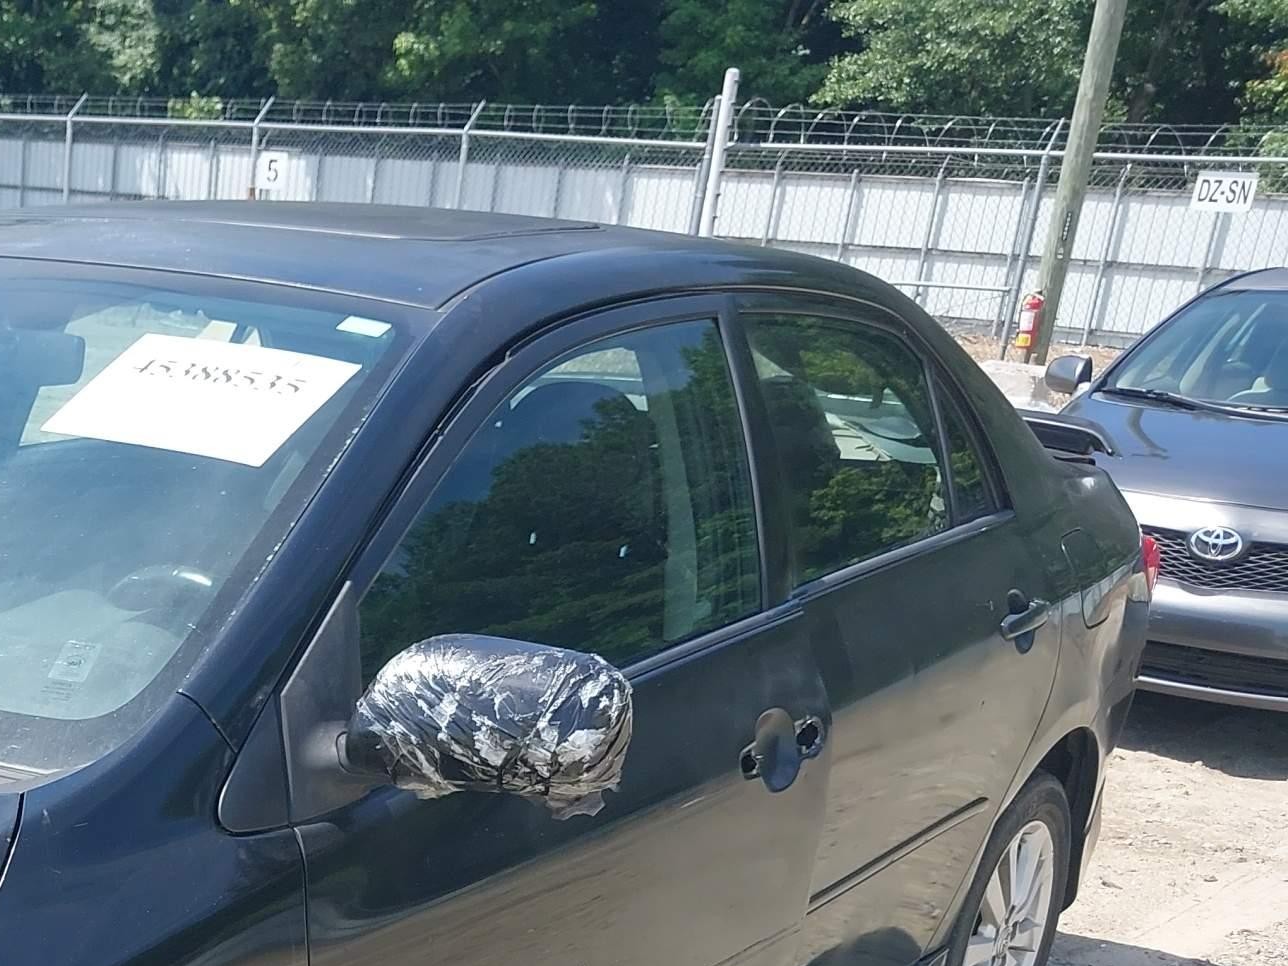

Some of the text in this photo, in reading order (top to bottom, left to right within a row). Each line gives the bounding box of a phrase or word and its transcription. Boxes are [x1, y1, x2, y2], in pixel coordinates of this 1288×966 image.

[267, 159, 279, 182] 5
[1197, 178, 1253, 205] DZ-SN
[133, 359, 308, 395] 45388535
